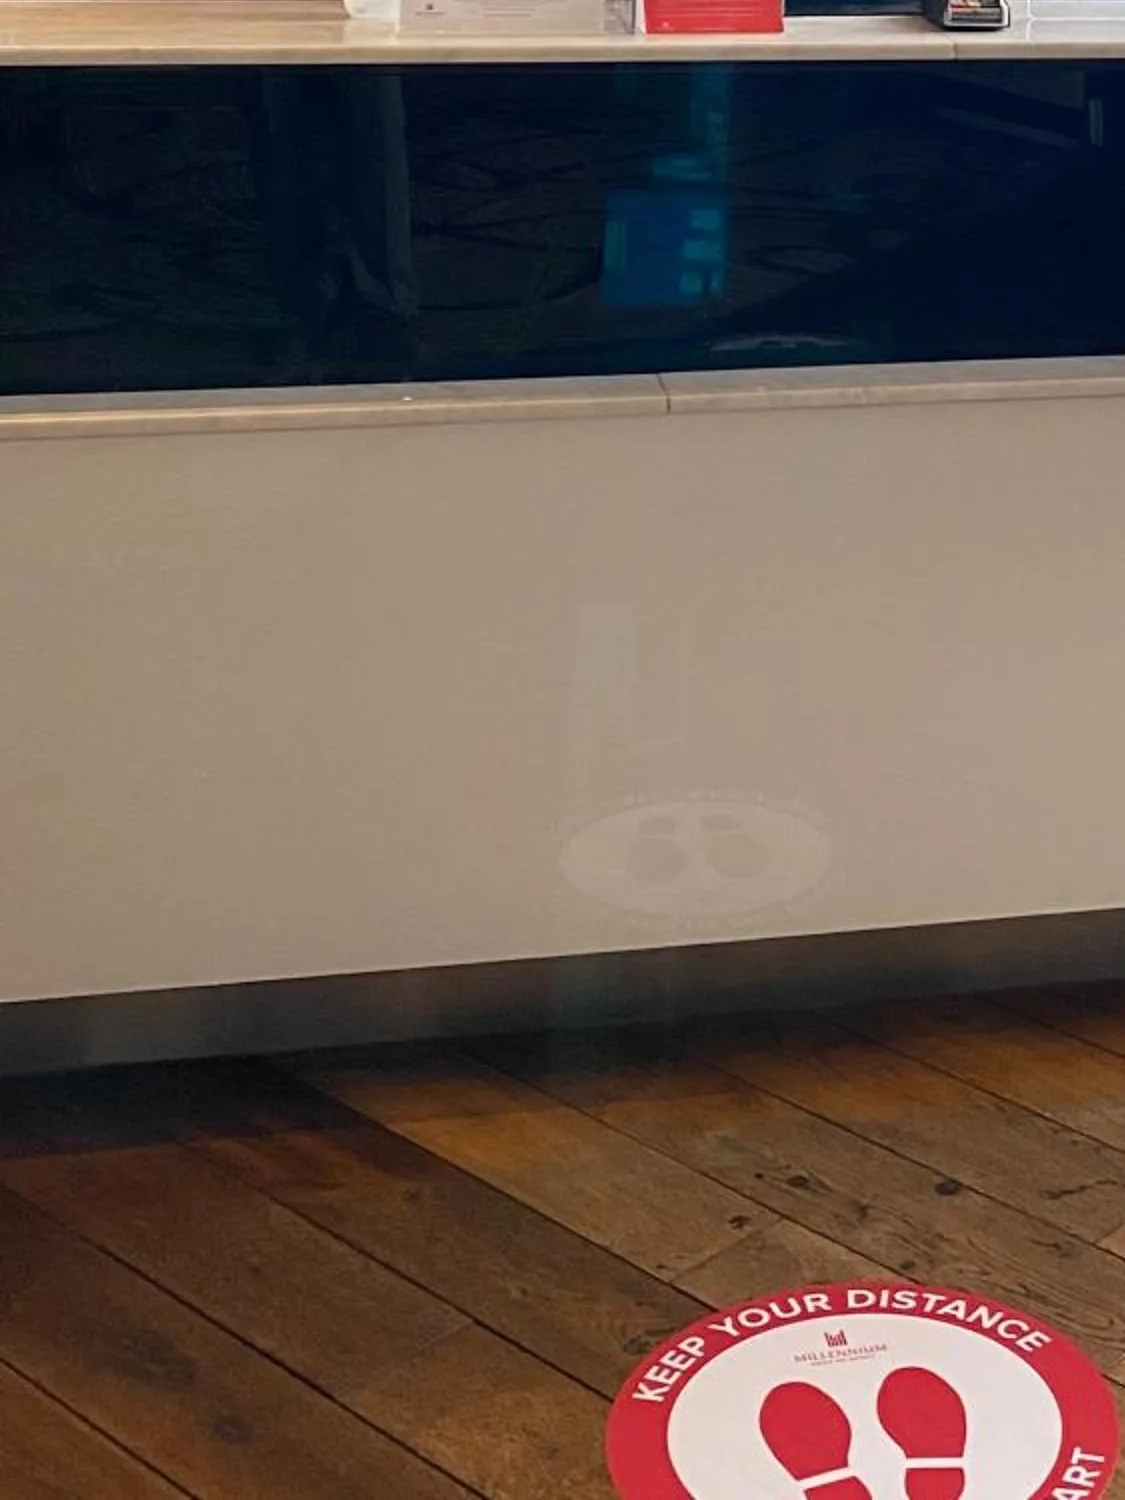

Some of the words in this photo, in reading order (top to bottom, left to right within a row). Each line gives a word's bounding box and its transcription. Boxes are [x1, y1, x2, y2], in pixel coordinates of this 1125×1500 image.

[632, 1335, 706, 1403] KEEP
[708, 1292, 832, 1338] YOUR
[846, 1288, 1055, 1353] DISTANCE
